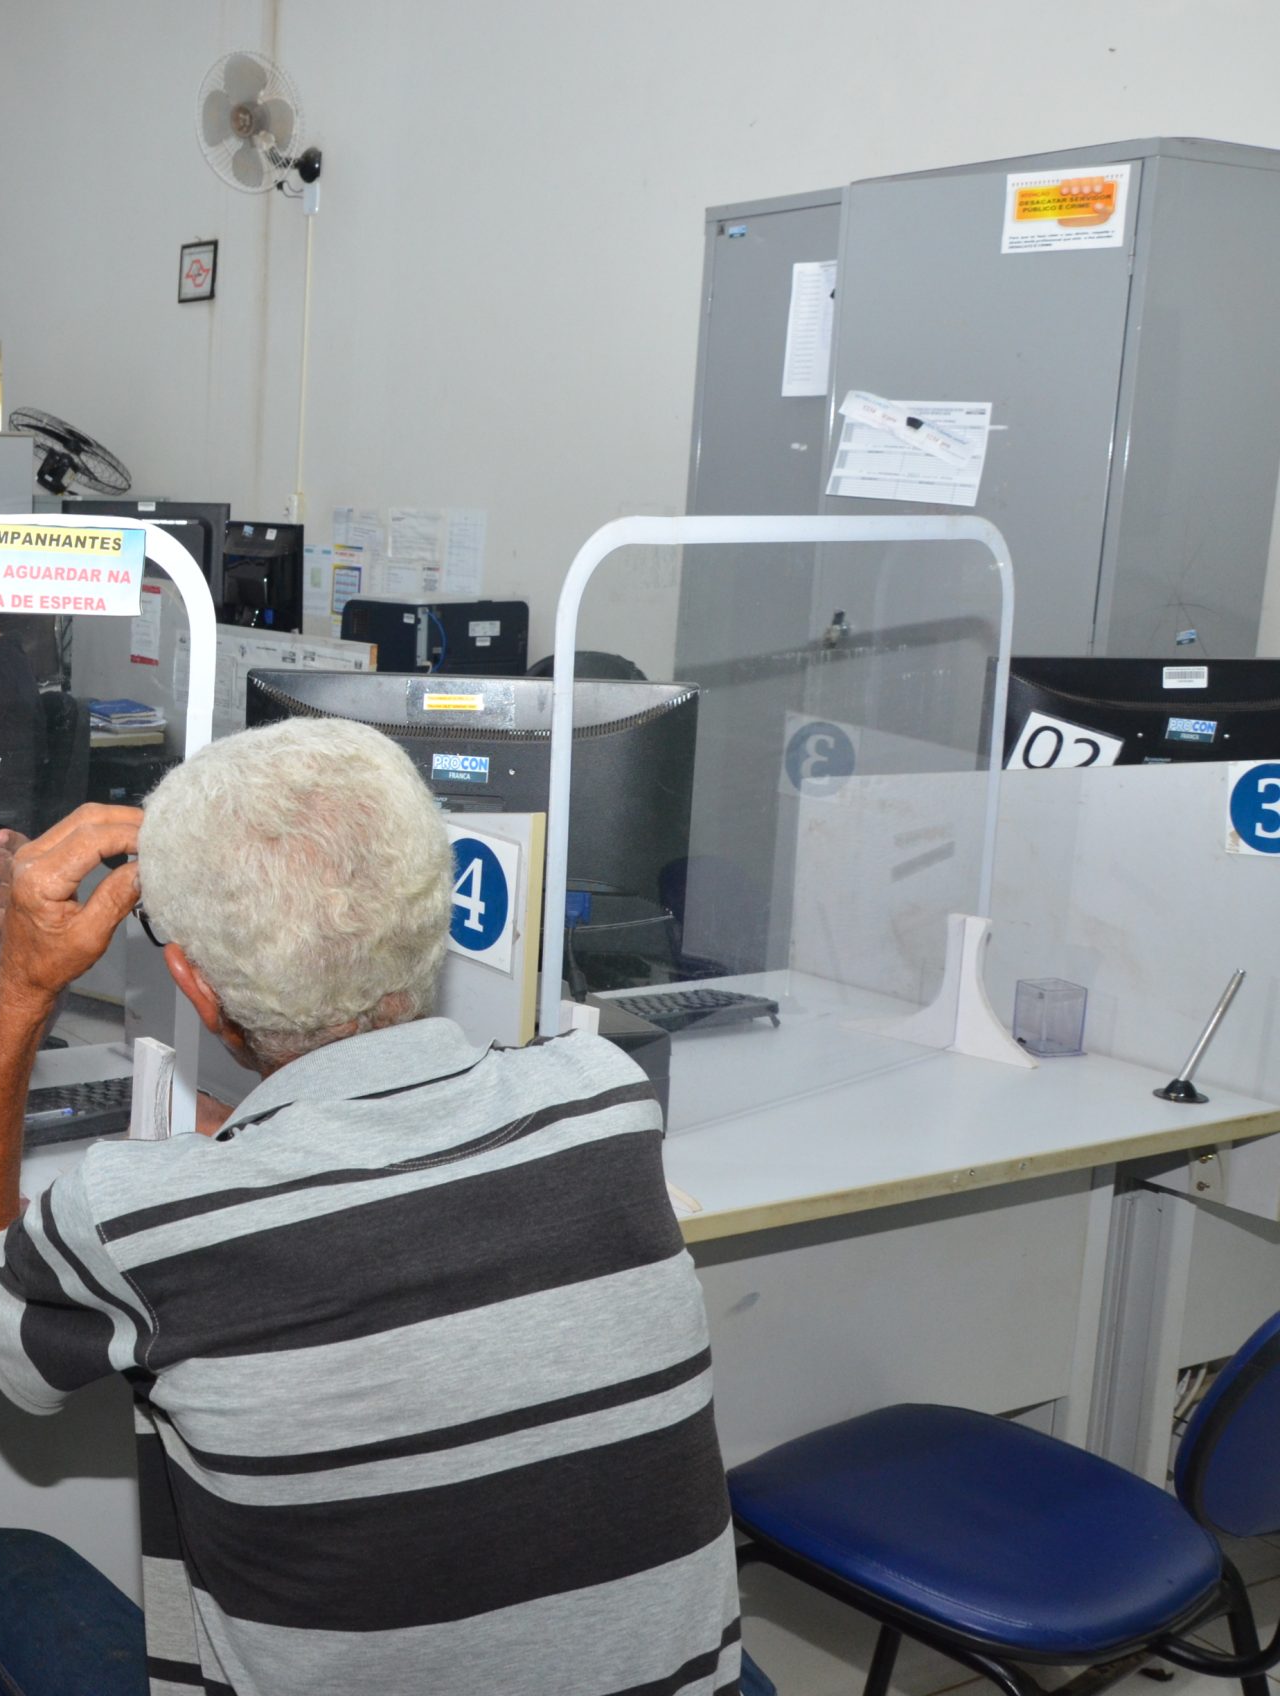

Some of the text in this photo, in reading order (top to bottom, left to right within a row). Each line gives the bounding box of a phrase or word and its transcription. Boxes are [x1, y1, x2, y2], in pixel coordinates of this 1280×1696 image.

[1019, 198, 1067, 206] DESACATAR
[3, 565, 101, 582] AGUARDAR
[108, 570, 131, 584] NA
[11, 594, 33, 609] DE
[40, 596, 106, 611] ESPERA
[1170, 718, 1216, 733] PROCON
[434, 754, 488, 771] PROCON
[448, 772, 471, 780] FRANCA
[1254, 777, 1280, 839] 3
[452, 857, 486, 933] 4
